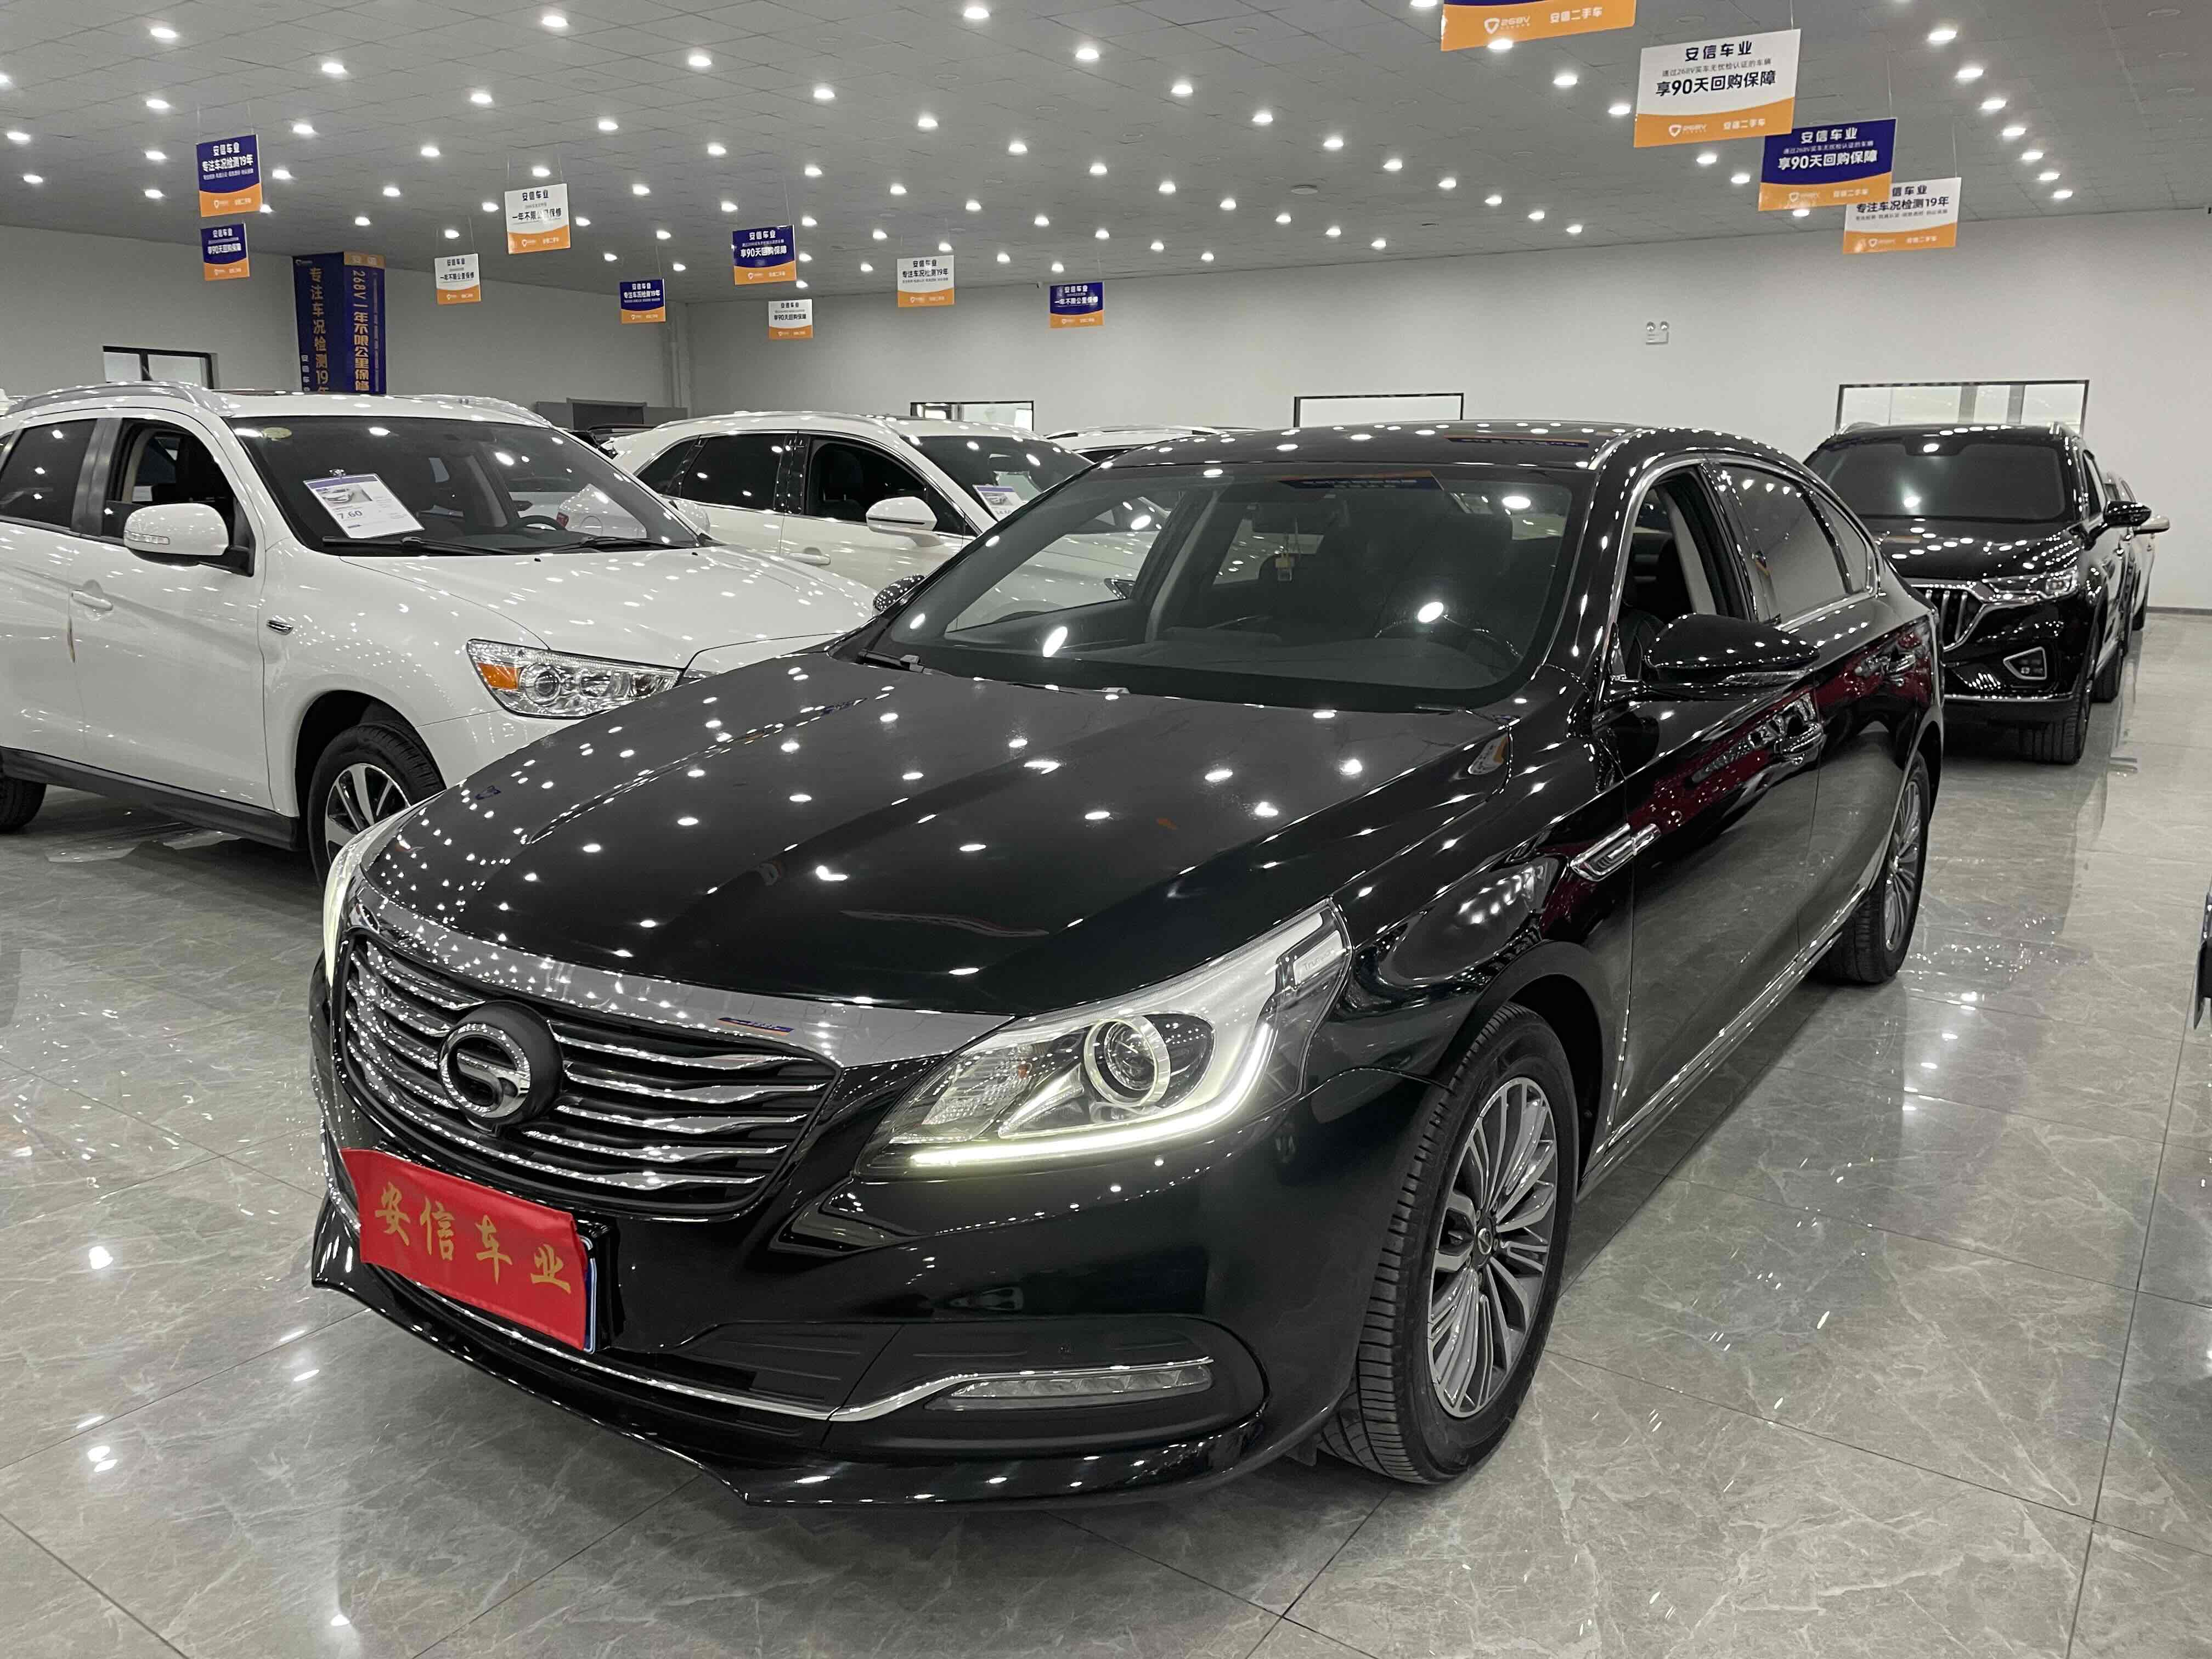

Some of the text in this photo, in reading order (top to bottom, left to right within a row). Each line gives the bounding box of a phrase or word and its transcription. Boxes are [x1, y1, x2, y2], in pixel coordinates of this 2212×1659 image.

[1550, 7, 1602, 23] 安信二手车
[1685, 41, 1752, 61] 安信车业
[1656, 70, 1776, 97] 享90天回购保障
[1801, 127, 1858, 144] 安信车业
[1778, 150, 1878, 170] 享90天回购保障
[522, 189, 549, 201] 安信车业
[1893, 185, 1927, 196] 信车业
[1857, 196, 1949, 213] 专注车况检测19年
[512, 208, 561, 219] 一年不限保修
[749, 230, 776, 240] 安信车业
[741, 245, 787, 258] 享90天回购保障
[902, 268, 949, 278] 专注车况检测19年
[337, 510, 363, 519] 7.60
[375, 1181, 571, 1294] 安信车业
